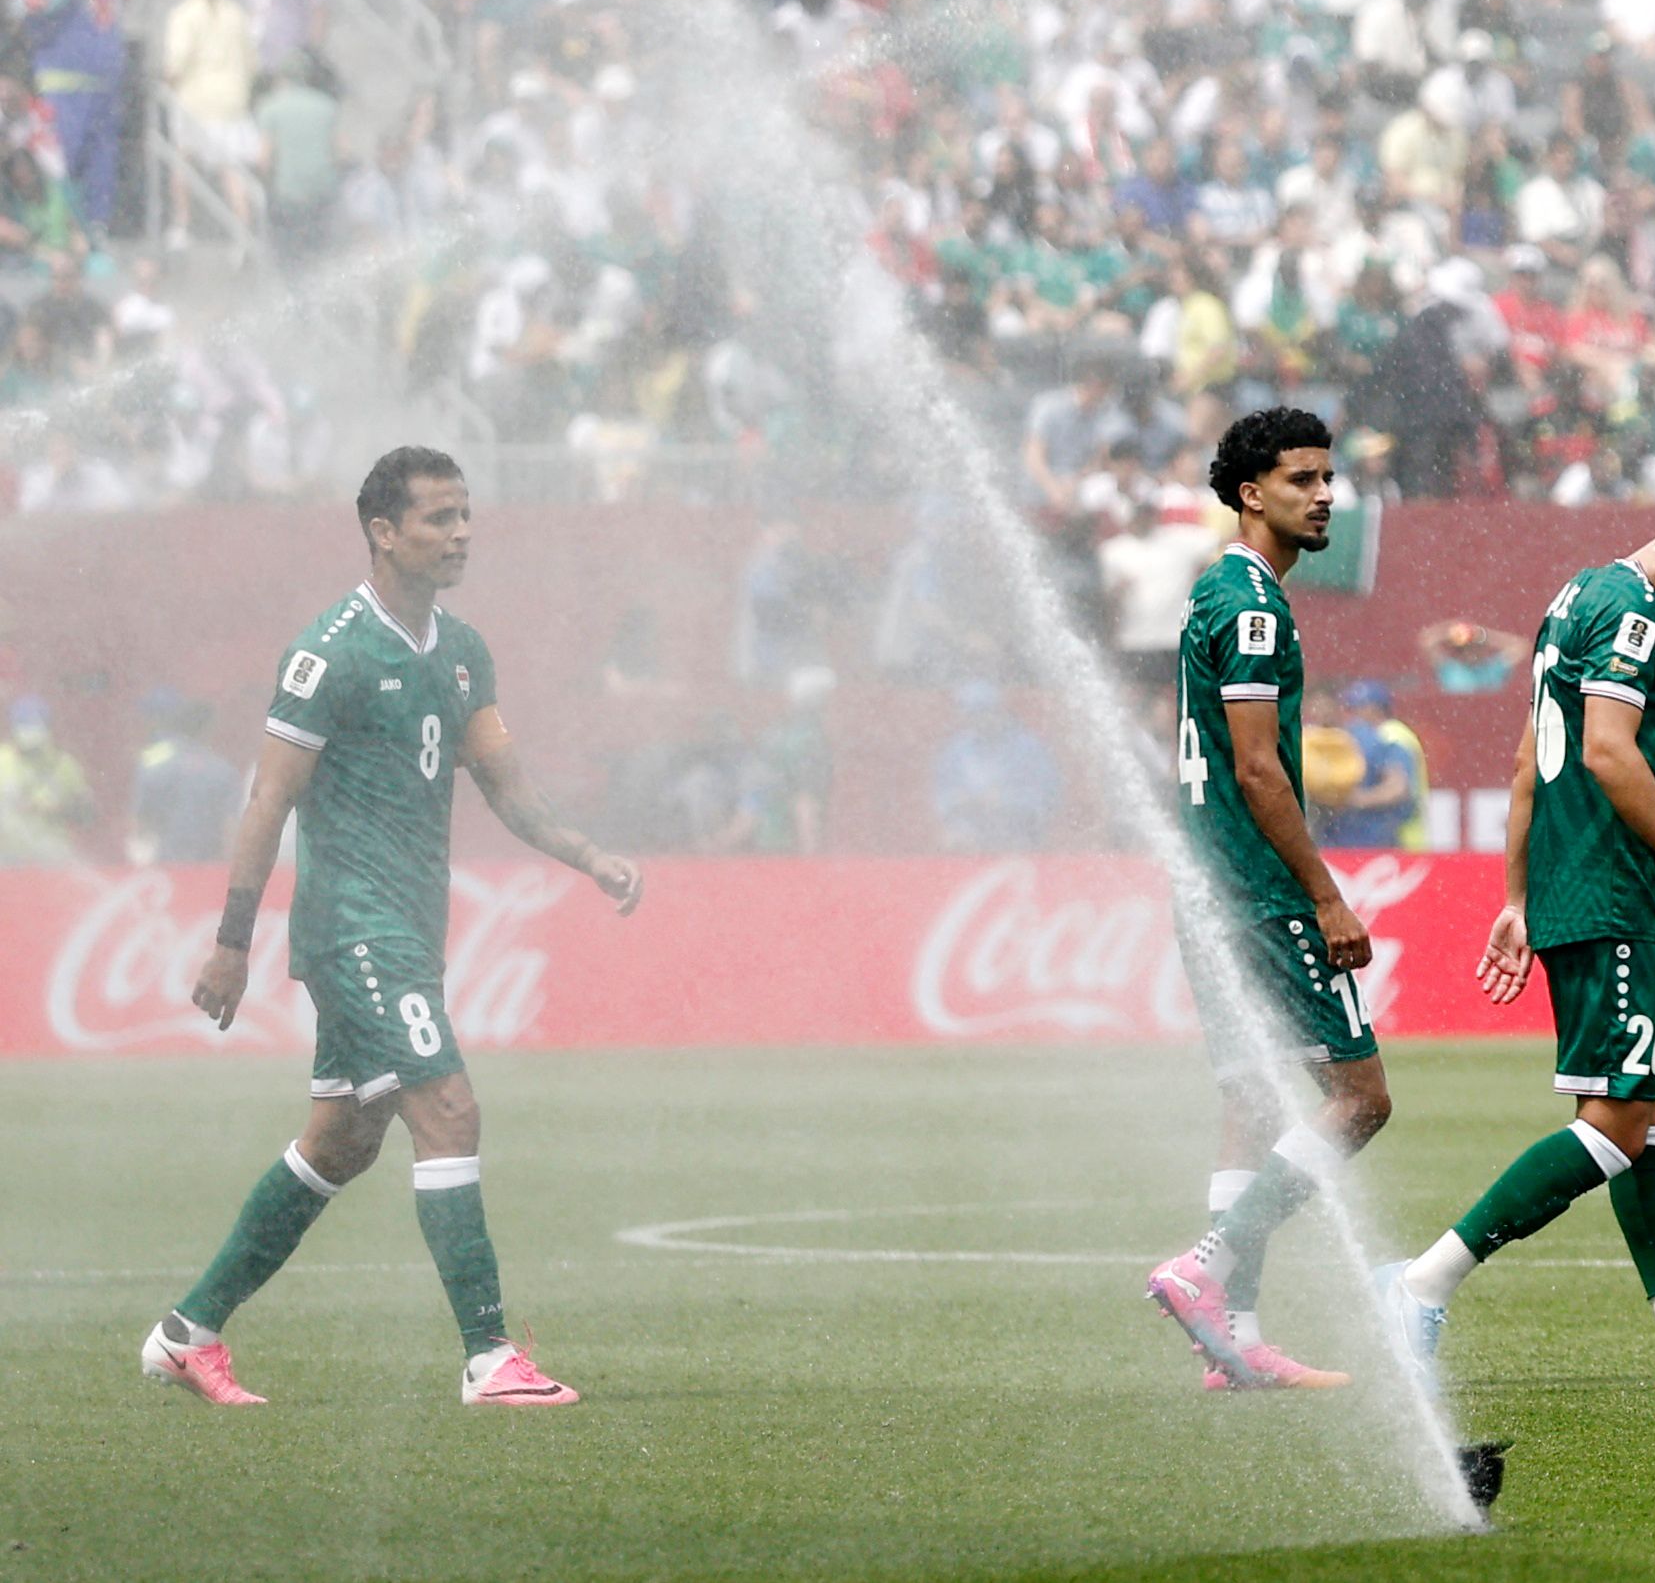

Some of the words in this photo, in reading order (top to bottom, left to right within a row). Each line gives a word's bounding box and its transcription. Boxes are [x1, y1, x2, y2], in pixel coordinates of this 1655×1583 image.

[379, 678, 402, 691] JAKO
[419, 714, 442, 780] 8
[399, 993, 442, 1057] 8
